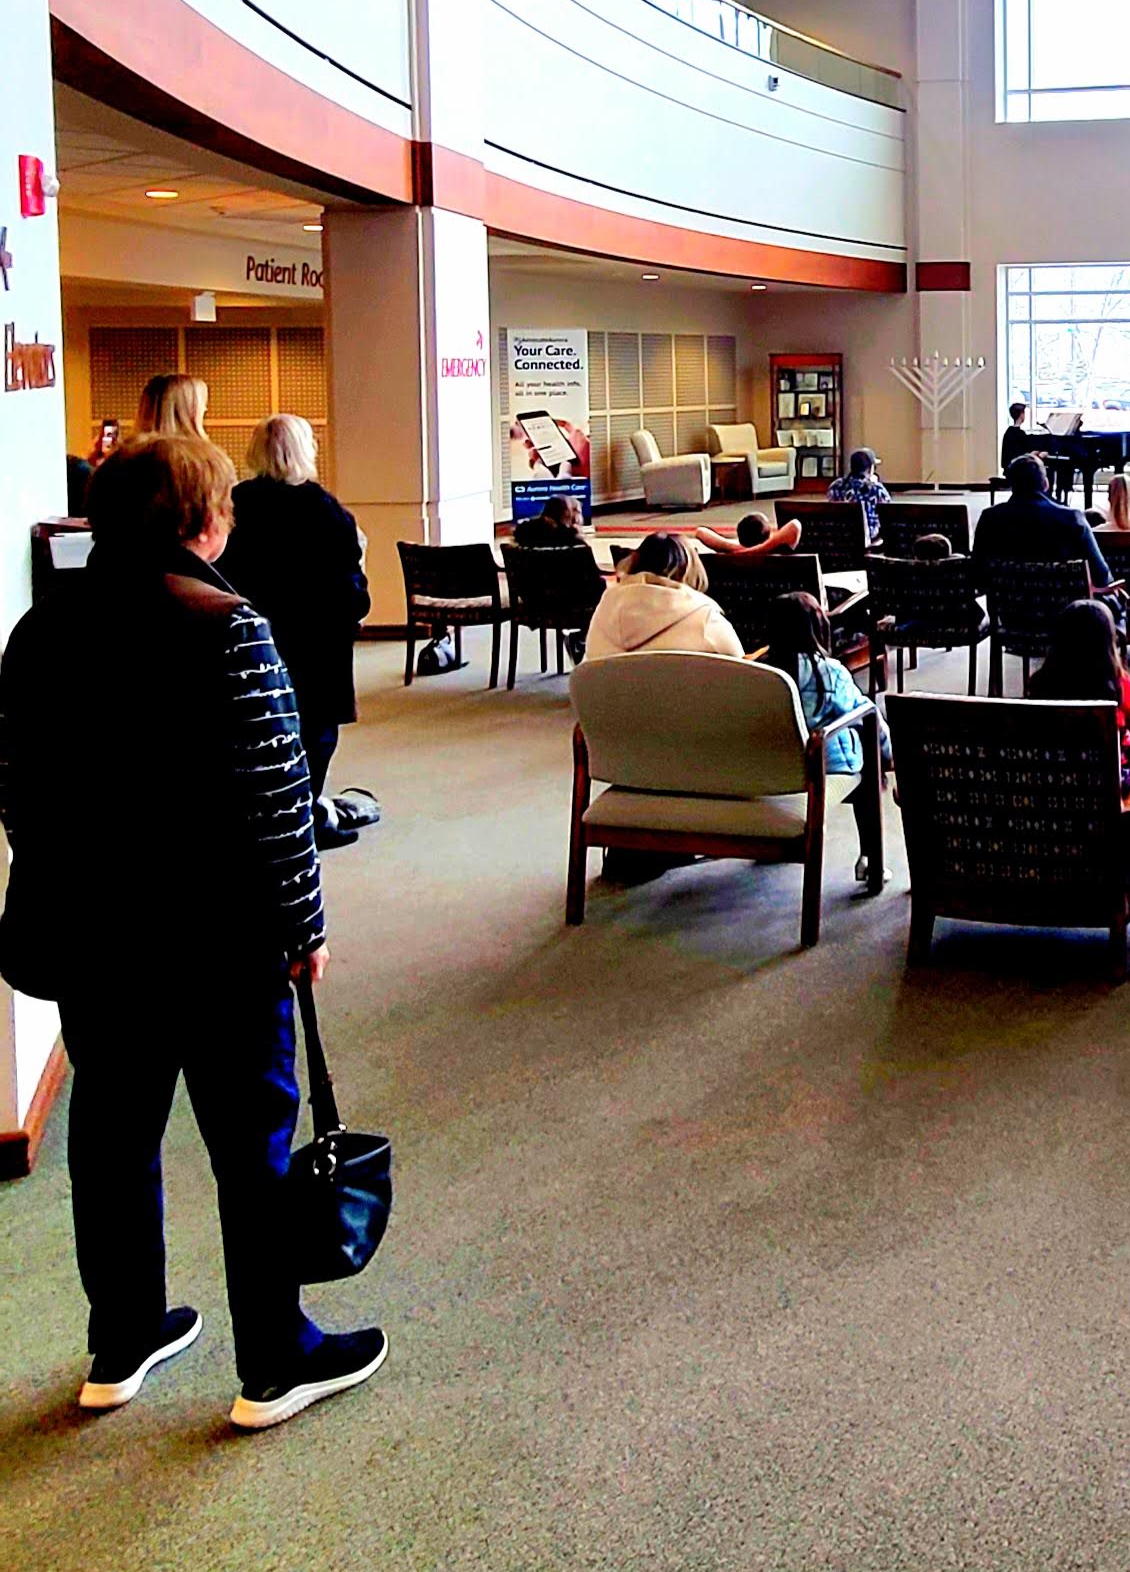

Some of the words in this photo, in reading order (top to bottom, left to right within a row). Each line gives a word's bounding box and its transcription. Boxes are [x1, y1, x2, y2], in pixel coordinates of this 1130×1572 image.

[246, 255, 297, 286] Patient
[514, 345, 542, 356] Your
[545, 345, 577, 356] Care.
[441, 358, 487, 378] EMERGENCY
[514, 359, 584, 370] Connected.
